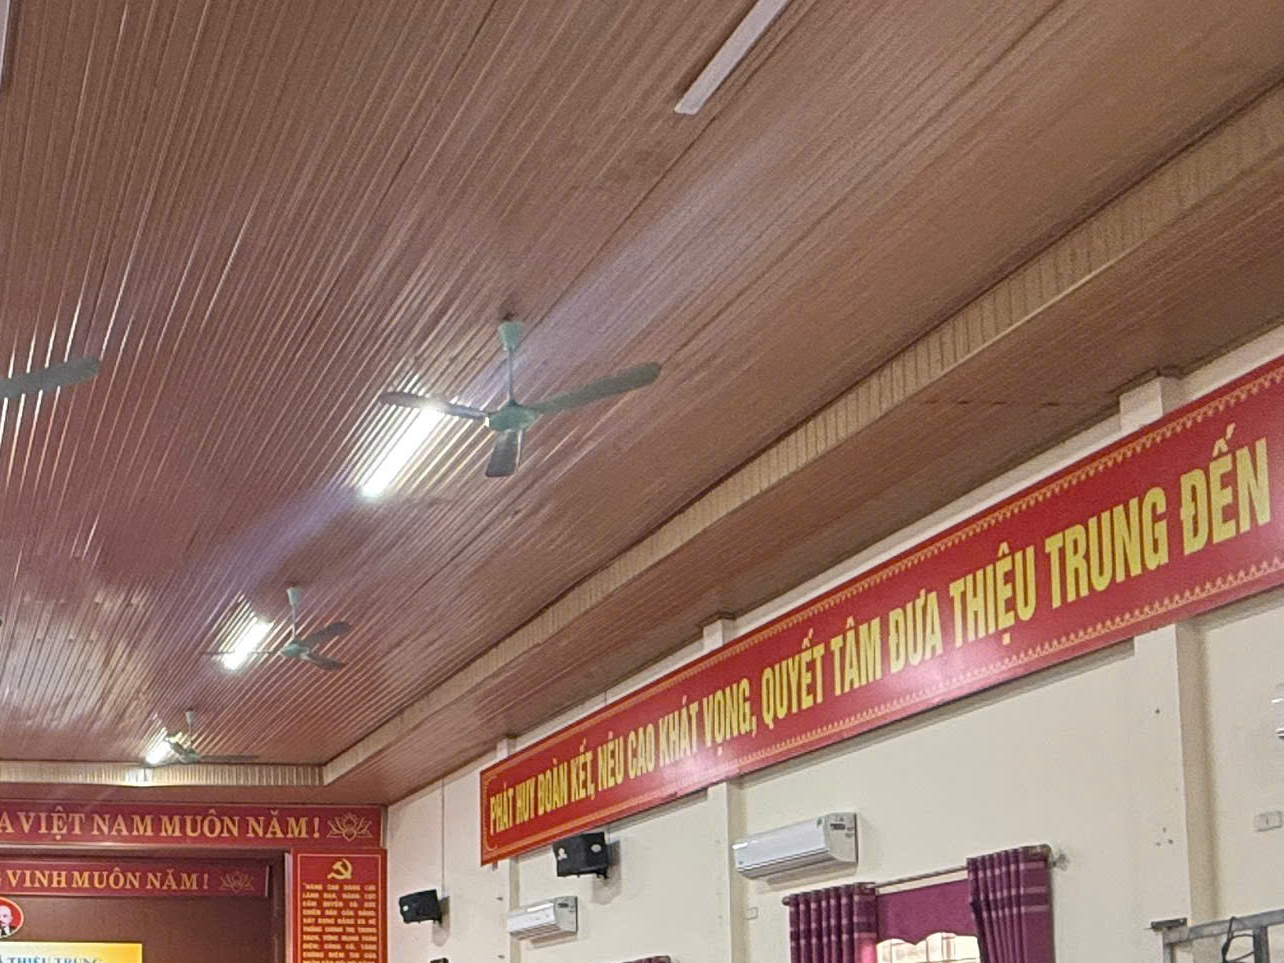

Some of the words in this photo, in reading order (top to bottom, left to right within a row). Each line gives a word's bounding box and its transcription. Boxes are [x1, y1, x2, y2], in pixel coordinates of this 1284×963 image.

[490, 782, 514, 836] PHÁT
[516, 776, 536, 824] HUY
[537, 758, 567, 816] ĐOÀN
[627, 723, 655, 780] CAO
[659, 695, 699, 767] KHÁT
[702, 678, 757, 756] VỌNG,
[761, 628, 825, 730] QUYẾT
[830, 616, 882, 697] TÂM
[888, 588, 943, 674] ĐƯA
[949, 542, 1036, 645] THIỆU
[1045, 486, 1169, 608] TRUNG
[1179, 423, 1272, 555] ĐẾN
[17, 806, 84, 840] VIỆT
[91, 813, 159, 837] NAM
[160, 808, 239, 838] MUÔN
[7, 869, 67, 888] VINH
[72, 867, 142, 889] MUÔN
